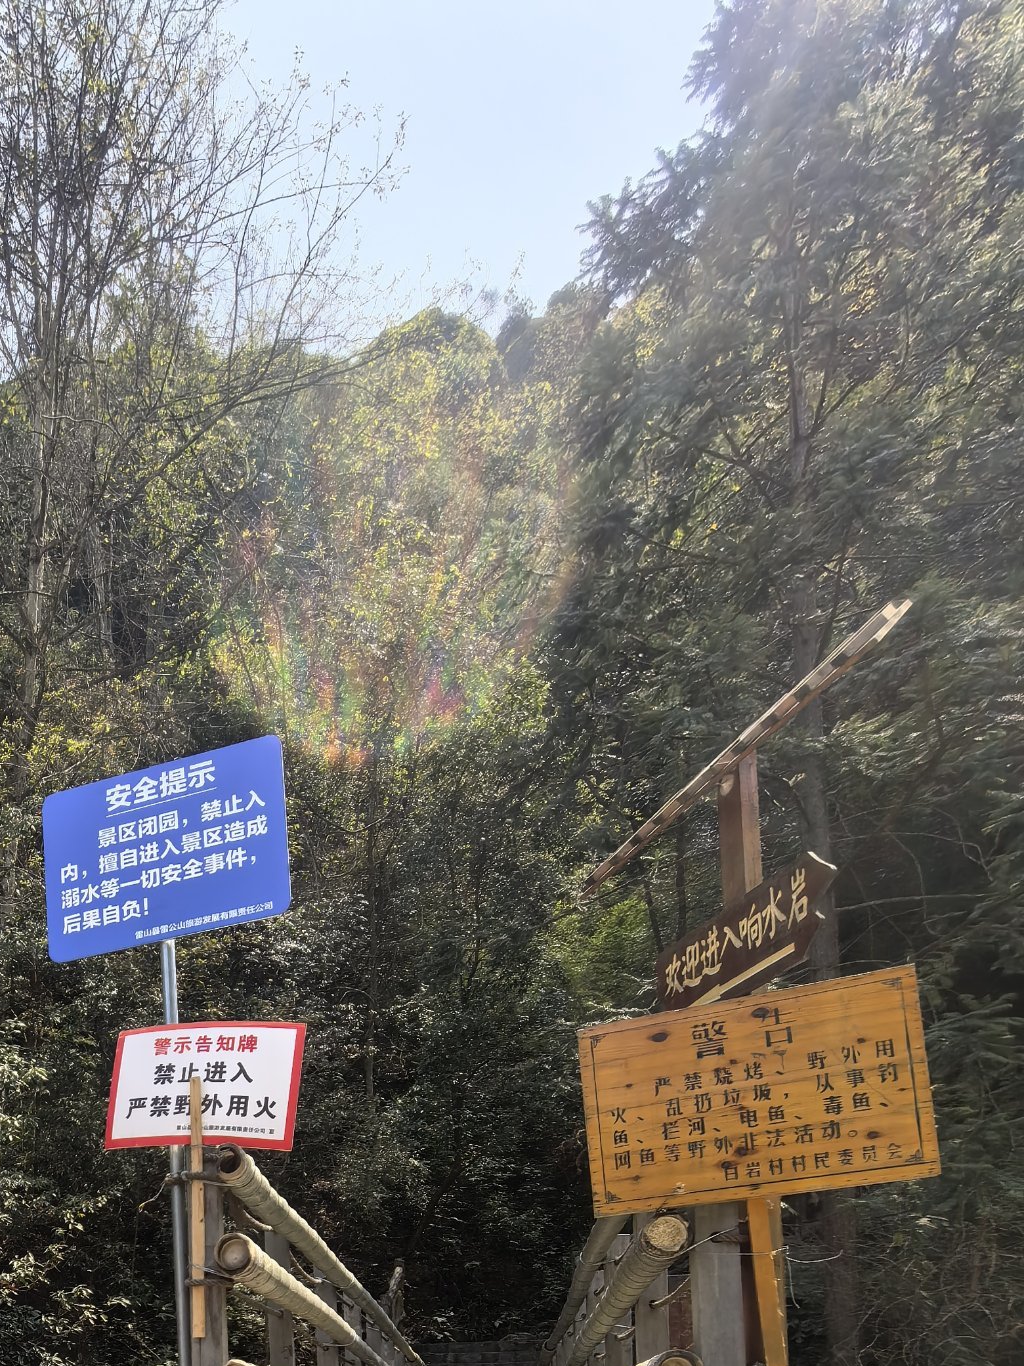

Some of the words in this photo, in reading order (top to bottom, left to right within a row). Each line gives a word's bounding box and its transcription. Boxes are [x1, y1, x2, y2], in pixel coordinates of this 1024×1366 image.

[105, 760, 216, 812] 安全提示
[97, 790, 266, 849] 景区闭园，禁止入
[60, 815, 268, 884] 内，擅自进入景区造成
[665, 868, 808, 997] 欢迎进入响水岩
[153, 1034, 258, 1056] 警示告知牌
[690, 1007, 797, 1059] 警告
[153, 1061, 254, 1085] 禁止进入
[126, 1093, 277, 1120] 严禁野外用火
[723, 1142, 903, 1181] 白岩村村民委员会
